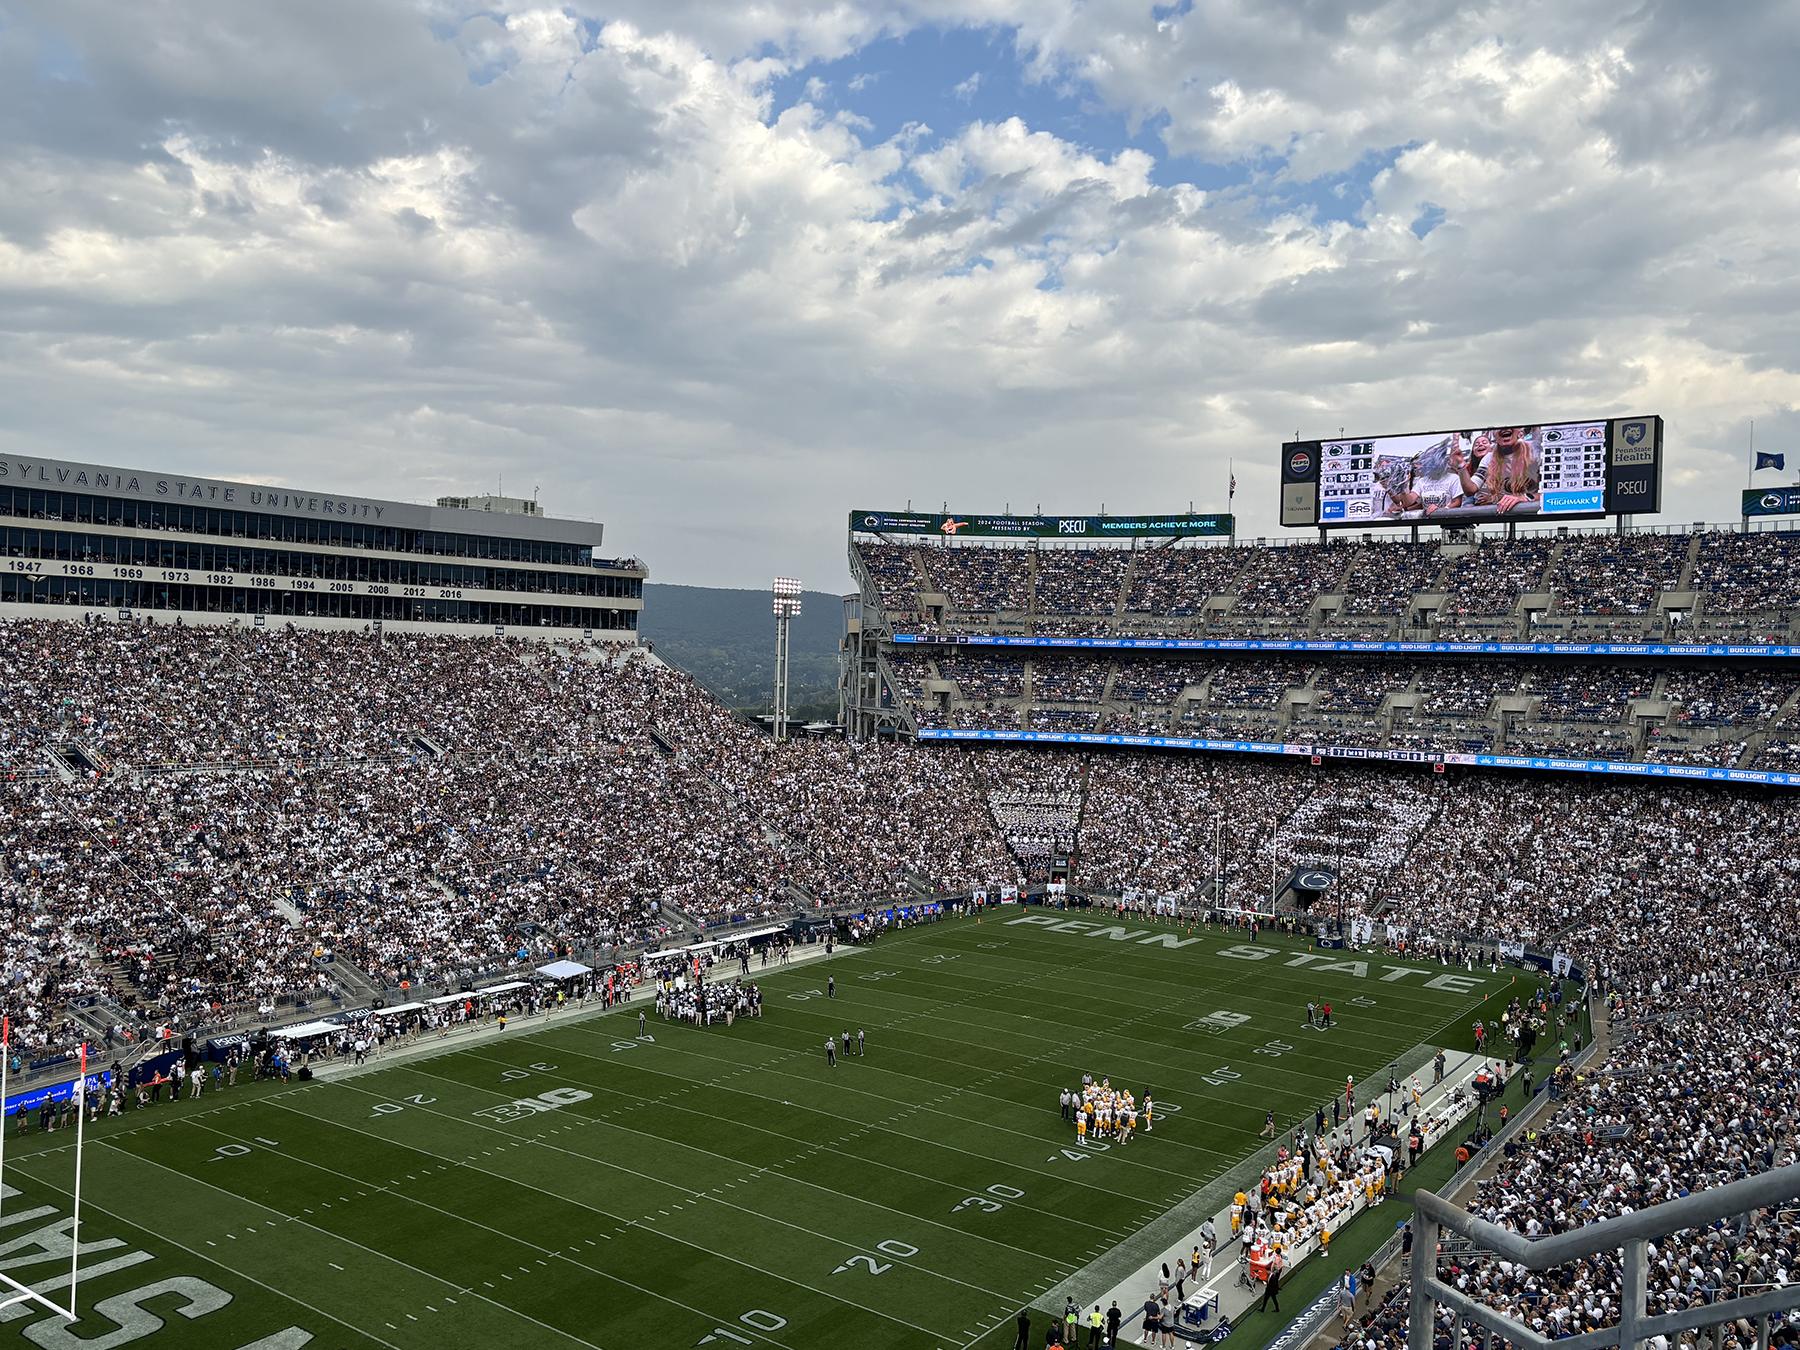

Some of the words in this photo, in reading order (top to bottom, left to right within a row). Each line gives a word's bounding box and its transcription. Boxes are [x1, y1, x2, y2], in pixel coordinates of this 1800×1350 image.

[1358, 444, 1364, 454] 7
[1615, 446, 1652, 454] PennState
[1615, 452, 1652, 462] Health
[1358, 459, 1364, 469] 0
[1617, 480, 1646, 495] PSECU
[156, 480, 235, 502] STATE
[250, 491, 385, 519] UNIVERSITY
[1548, 497, 1590, 506] HIGHMARK
[1058, 520, 1086, 533] PSECU
[8, 561, 42, 572] 1947
[62, 564, 94, 575] 1968
[113, 568, 143, 578] 1969
[161, 571, 190, 581] 1973
[207, 574, 233, 585] 1982
[250, 577, 275, 587] 1986
[291, 580, 315, 590] 1994
[330, 583, 354, 592] 2005
[368, 585, 389, 594] 2008
[404, 588, 425, 597] 2012
[440, 590, 462, 598] 2016
[1745, 772, 1767, 780] LIGHT
[1002, 915, 1204, 949] PENN
[1216, 944, 1486, 994] STATE
[787, 989, 823, 1000] 40
[610, 1033, 656, 1049] 40
[1253, 1041, 1294, 1057] 30
[501, 1062, 558, 1079] 30
[1201, 1068, 1242, 1086] 40
[372, 1093, 437, 1114] 20
[214, 1136, 280, 1156] 10
[1060, 1140, 1111, 1162] 40
[961, 1184, 1025, 1213] 30
[845, 1239, 920, 1276] 20
[712, 1309, 788, 1346] 10
